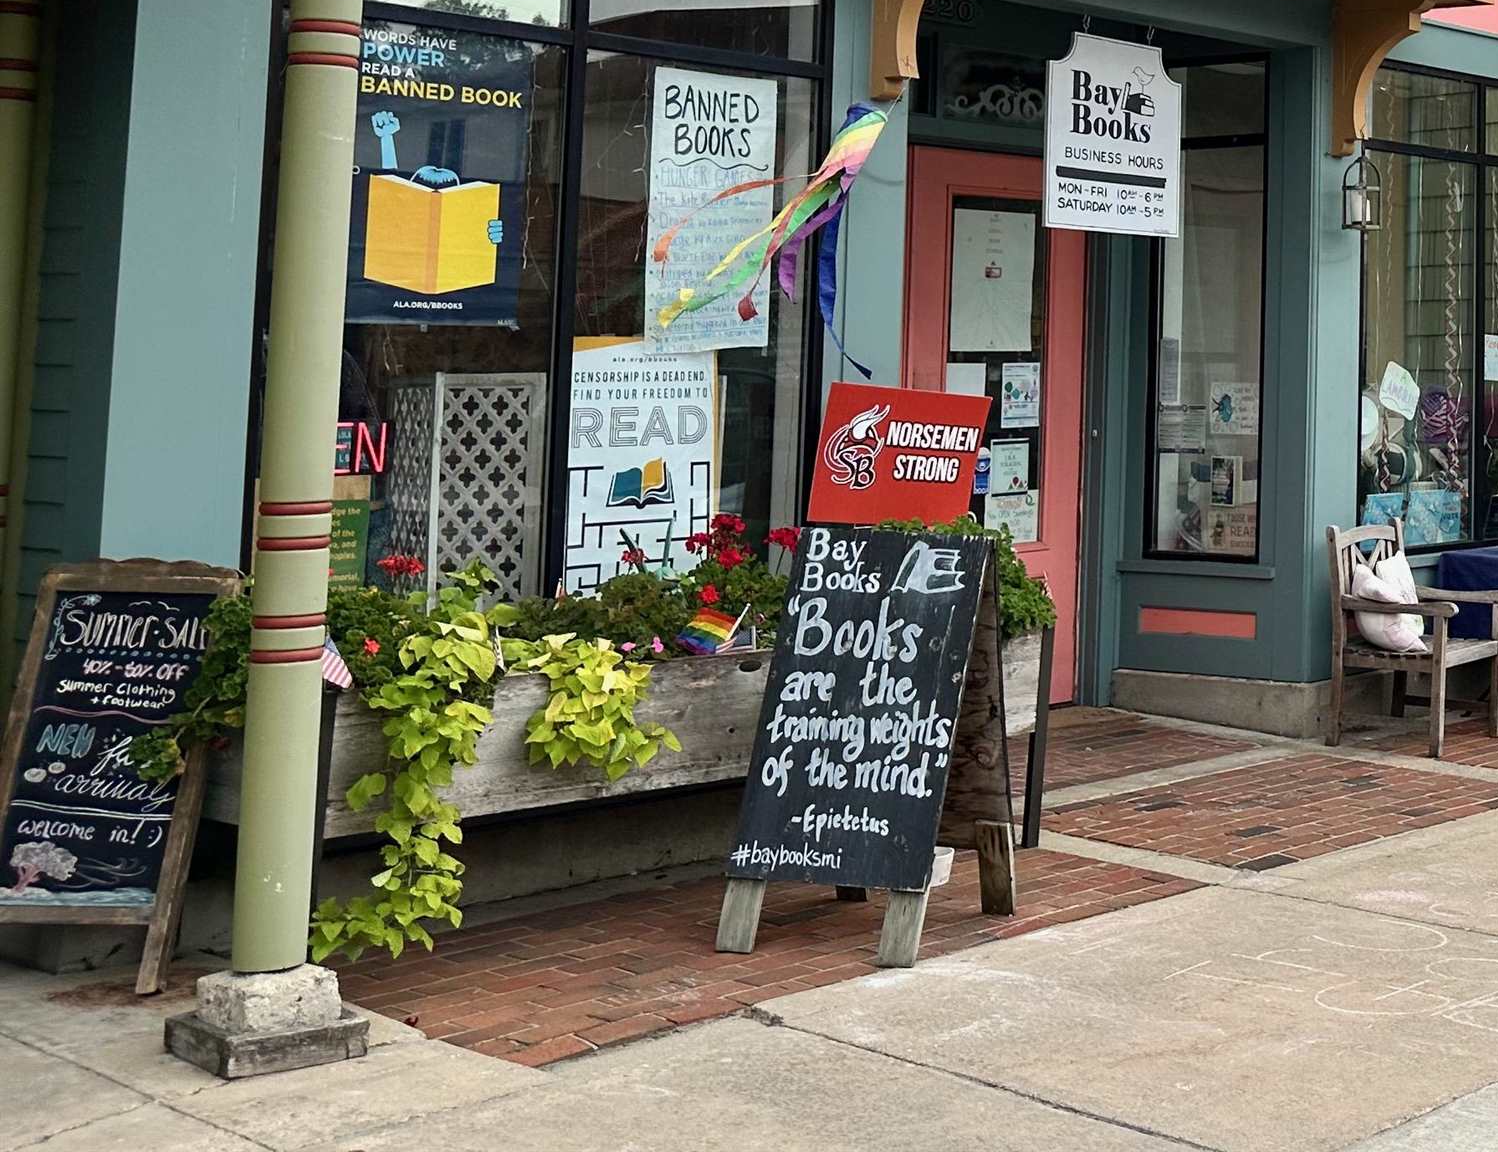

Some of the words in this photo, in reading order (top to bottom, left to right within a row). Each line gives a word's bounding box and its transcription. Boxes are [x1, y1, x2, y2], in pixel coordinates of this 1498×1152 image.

[363, 28, 416, 44] WORDS
[420, 37, 457, 51] HAVE
[363, 42, 445, 67] POWER
[362, 62, 400, 76] READ
[405, 68, 415, 78] A
[361, 76, 455, 101] BANNED
[461, 87, 523, 109] BOOK
[664, 85, 759, 124] BANNED
[1071, 69, 1123, 114] Bay
[1070, 102, 1151, 143] Books
[674, 123, 751, 158] BOOKS
[1065, 147, 1122, 164] BUSINESS
[1128, 155, 1164, 170] HOURS
[1057, 197, 1113, 213] SATURDAY
[574, 371, 639, 383] CENSORSHIP
[642, 371, 651, 382] IS
[654, 371, 660, 382] A
[662, 371, 685, 382] DEAD
[688, 370, 705, 382] END
[573, 389, 601, 400] FIND
[608, 388, 637, 400] YOUR
[642, 388, 691, 399] FREEDOM
[696, 387, 708, 398] TO
[572, 404, 708, 449] READ
[885, 421, 979, 452] NORSEMEN
[335, 422, 387, 473] EN
[892, 454, 960, 482] STRONG
[806, 528, 867, 570] Bay
[800, 562, 881, 593] Books
[116, 682, 176, 704] Clothing
[780, 671, 836, 701] are
[859, 661, 918, 708] the
[36, 723, 97, 759] NEW
[767, 703, 865, 762] training
[870, 700, 952, 761] weights
[761, 745, 794, 797] of
[805, 747, 849, 790] the
[54, 774, 176, 813] arrivals
[109, 818, 145, 844] in!
[730, 839, 843, 872] #baybooksmi
